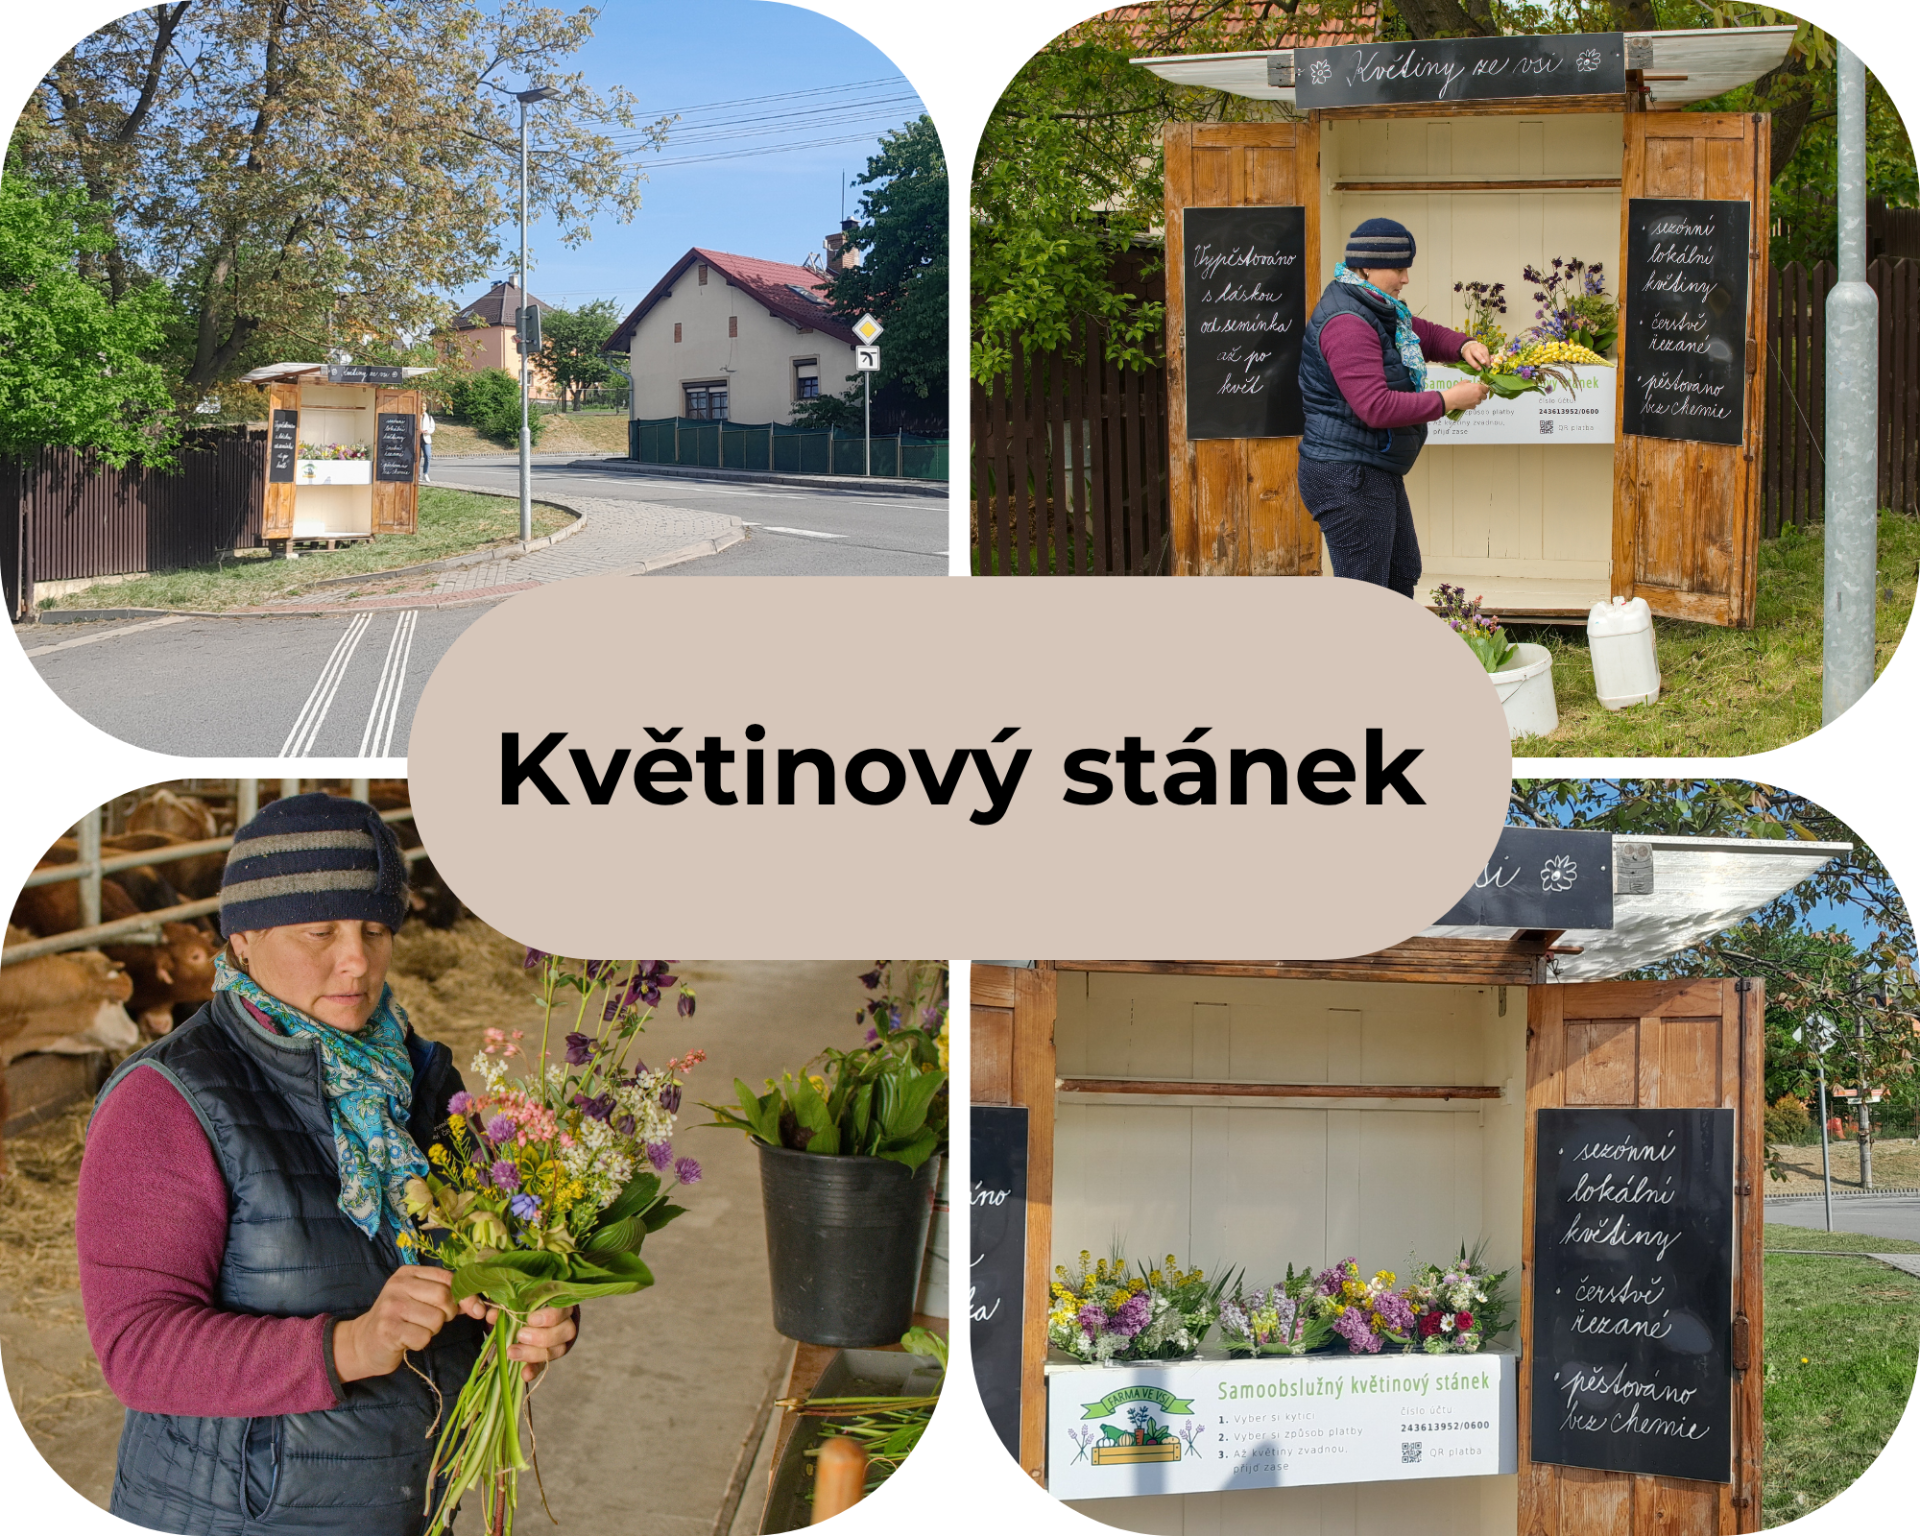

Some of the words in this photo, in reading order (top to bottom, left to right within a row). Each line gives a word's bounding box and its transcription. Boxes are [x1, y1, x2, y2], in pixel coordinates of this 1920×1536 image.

[1346, 48, 1464, 99] Květiny
[1473, 57, 1511, 76] ze
[1513, 52, 1564, 75] vsi
[1651, 214, 1715, 237] sezónní
[1194, 243, 1297, 280] Vypěstováno
[1647, 243, 1715, 265] lokální
[1201, 290, 1213, 303] s
[1214, 282, 1283, 303] láskou
[1642, 270, 1718, 303] květiny
[1200, 317, 1221, 334] od
[1221, 312, 1293, 334] semínka
[1651, 311, 1708, 333] čerstvě
[1216, 346, 1242, 363] až
[1244, 351, 1272, 373] po
[1217, 373, 1264, 395] květ
[1641, 368, 1725, 400] pěstováno
[1640, 394, 1671, 416] bez
[1671, 394, 1732, 419] chemie
[1573, 1129, 1676, 1163] sezónní
[1567, 1172, 1676, 1205] lokální
[1559, 1214, 1682, 1261] květiny
[1574, 1274, 1665, 1305] čerstvě
[1571, 1308, 1672, 1339] řezané
[1107, 1388, 1140, 1407] FARMA
[1142, 1388, 1154, 1399] VE
[1155, 1390, 1171, 1405] VSI
[1218, 1375, 1343, 1400] Samoobslužný
[1351, 1372, 1429, 1397] květinový
[1435, 1371, 1490, 1391] stánek
[1561, 1366, 1698, 1409] pěstováno
[1218, 1416, 1229, 1424] 1.
[1234, 1414, 1266, 1425] Vyber
[1271, 1413, 1280, 1422] si
[1285, 1412, 1315, 1423] kytici
[1400, 1407, 1425, 1416] číslo
[1559, 1401, 1608, 1440] bez
[1610, 1402, 1711, 1440] chemie
[1218, 1433, 1229, 1442] 2.
[1234, 1432, 1266, 1443] Vyber
[1271, 1430, 1280, 1439] si
[1284, 1427, 1324, 1440] způsob
[1328, 1426, 1363, 1437] platby
[1400, 1420, 1490, 1432] 243613952/0600
[1218, 1450, 1229, 1459] 3.
[1233, 1449, 1247, 1458] Až
[1252, 1446, 1293, 1458] květiny
[1430, 1448, 1445, 1458] QR
[1449, 1447, 1482, 1457] platba
[1233, 1463, 1259, 1475] přijď
[1263, 1463, 1289, 1472] zase
